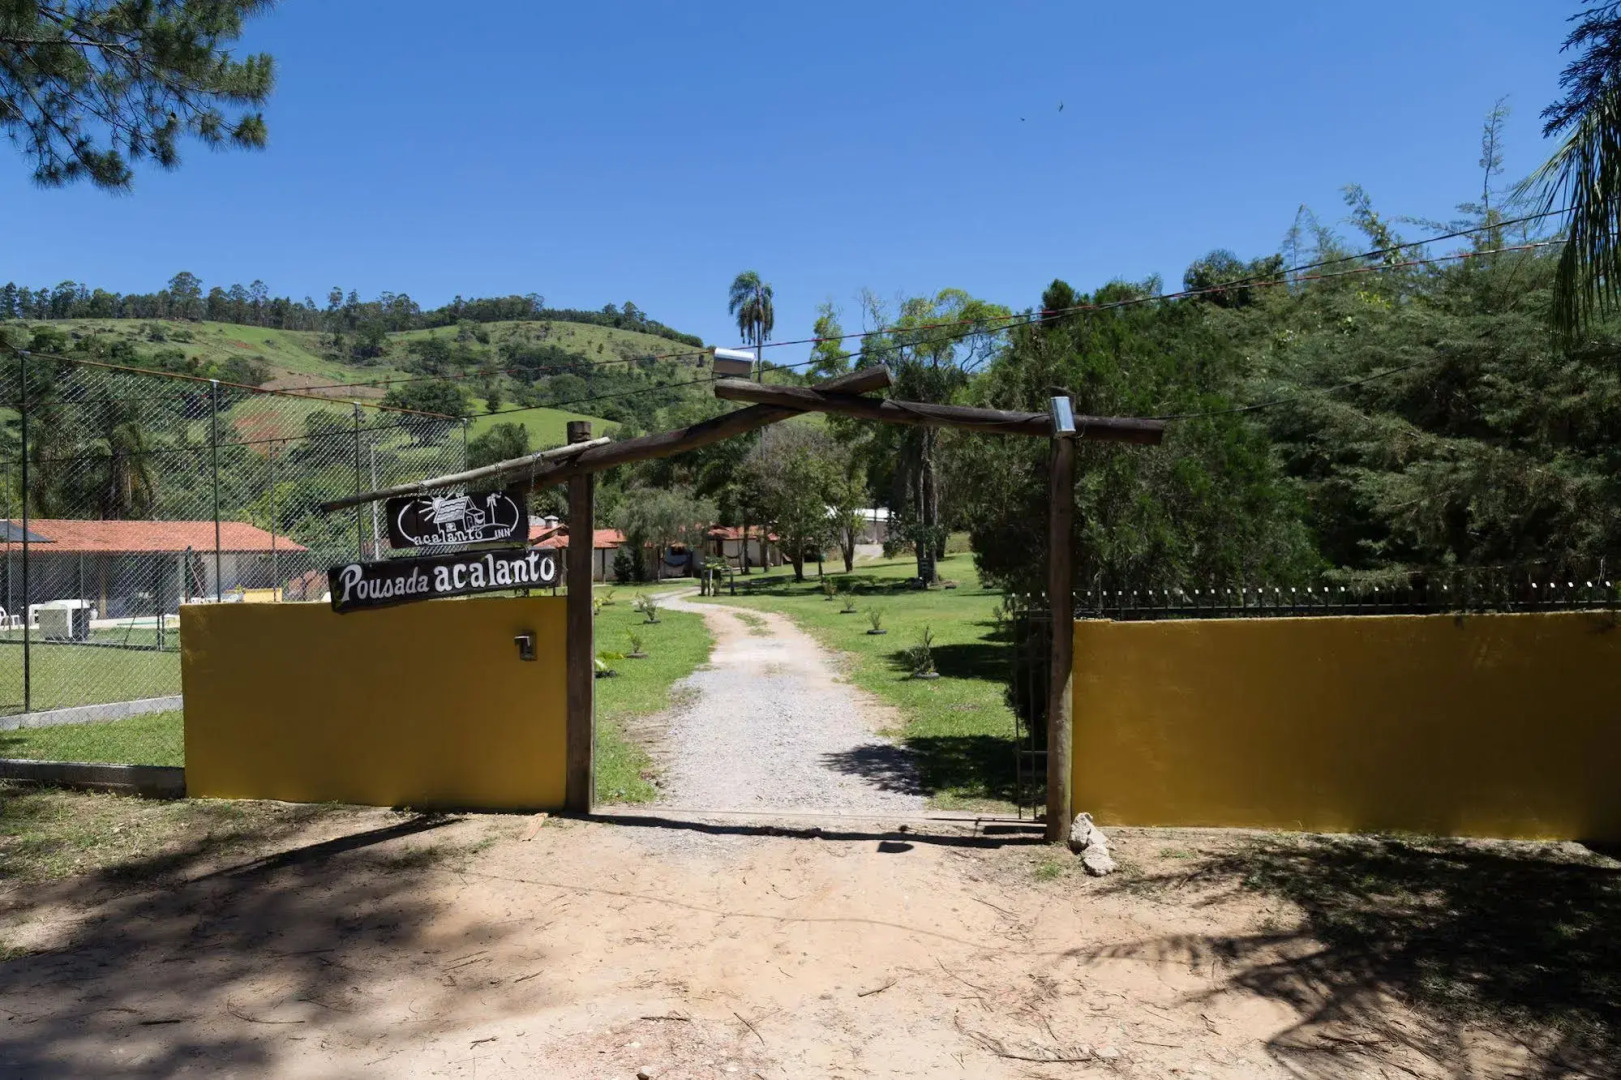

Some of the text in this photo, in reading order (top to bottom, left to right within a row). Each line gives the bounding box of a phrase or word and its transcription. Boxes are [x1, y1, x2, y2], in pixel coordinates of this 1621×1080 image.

[413, 528, 511, 546] acalanto INN
[339, 551, 555, 602] Pousada acalanto
